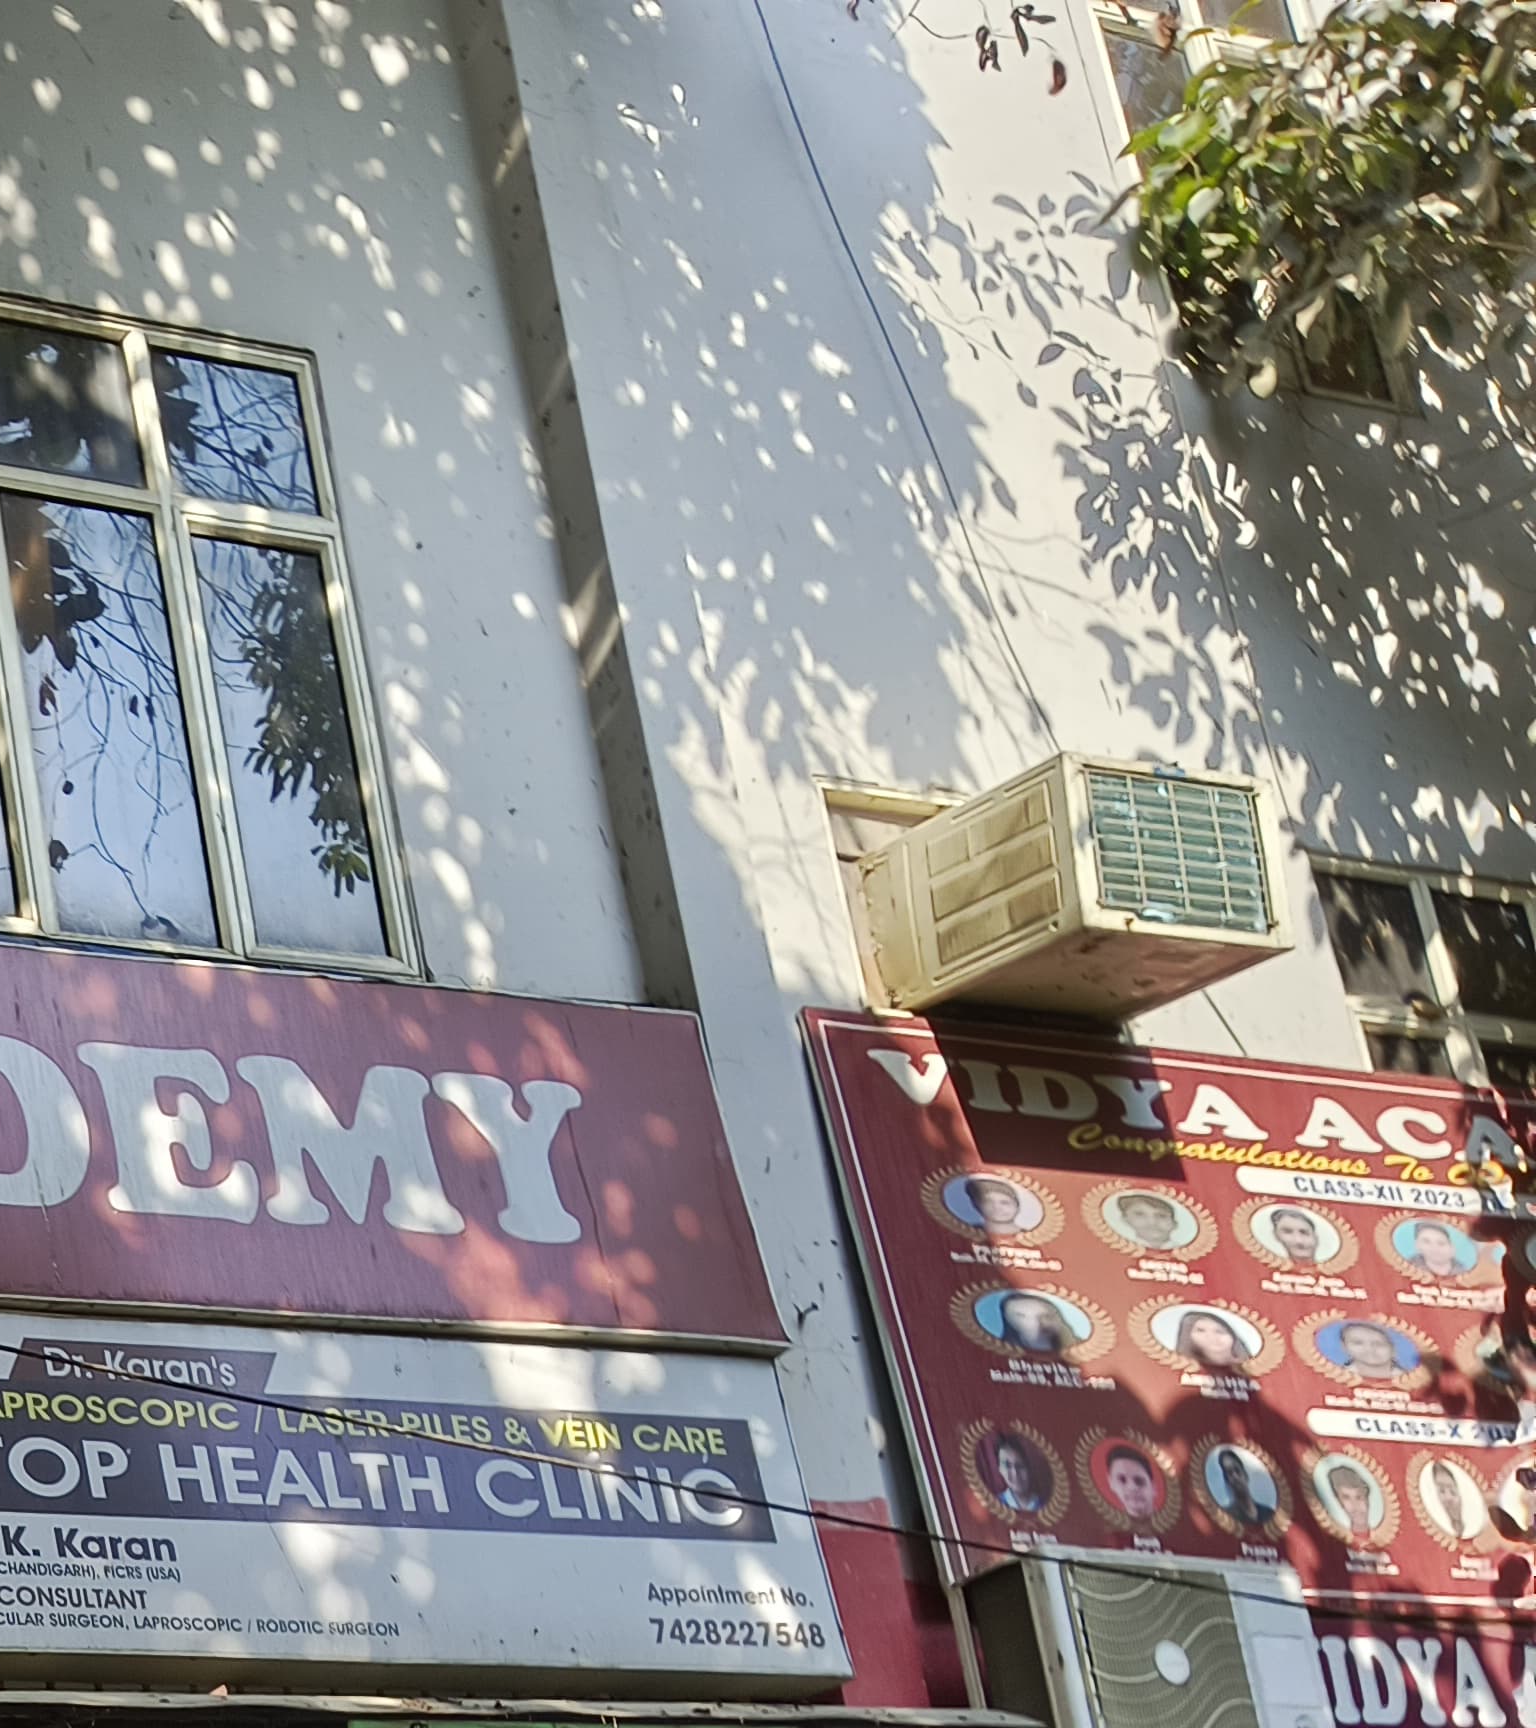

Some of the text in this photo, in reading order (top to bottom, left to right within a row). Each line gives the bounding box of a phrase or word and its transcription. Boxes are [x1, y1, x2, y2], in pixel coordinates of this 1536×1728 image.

[866, 1047, 1269, 1142] VIDYA
[43, 1346, 238, 1390] Dr. Karan's
[276, 1403, 392, 1443] LASER
[400, 1410, 491, 1447] PILES
[540, 1416, 622, 1453] VEIN
[632, 1422, 728, 1459] CARE
[159, 1444, 449, 1517] HEALTH
[474, 1455, 745, 1528] CLINIC
[3, 1525, 41, 1557] K.
[55, 1527, 177, 1562] Karan
[647, 1580, 776, 1610] Appointment
[134, 1615, 242, 1632] LAPROSCOPIC
[257, 1619, 323, 1635] ROBOTIC
[328, 1621, 400, 1636] SURGEON
[649, 1617, 827, 1650] 7428227548
